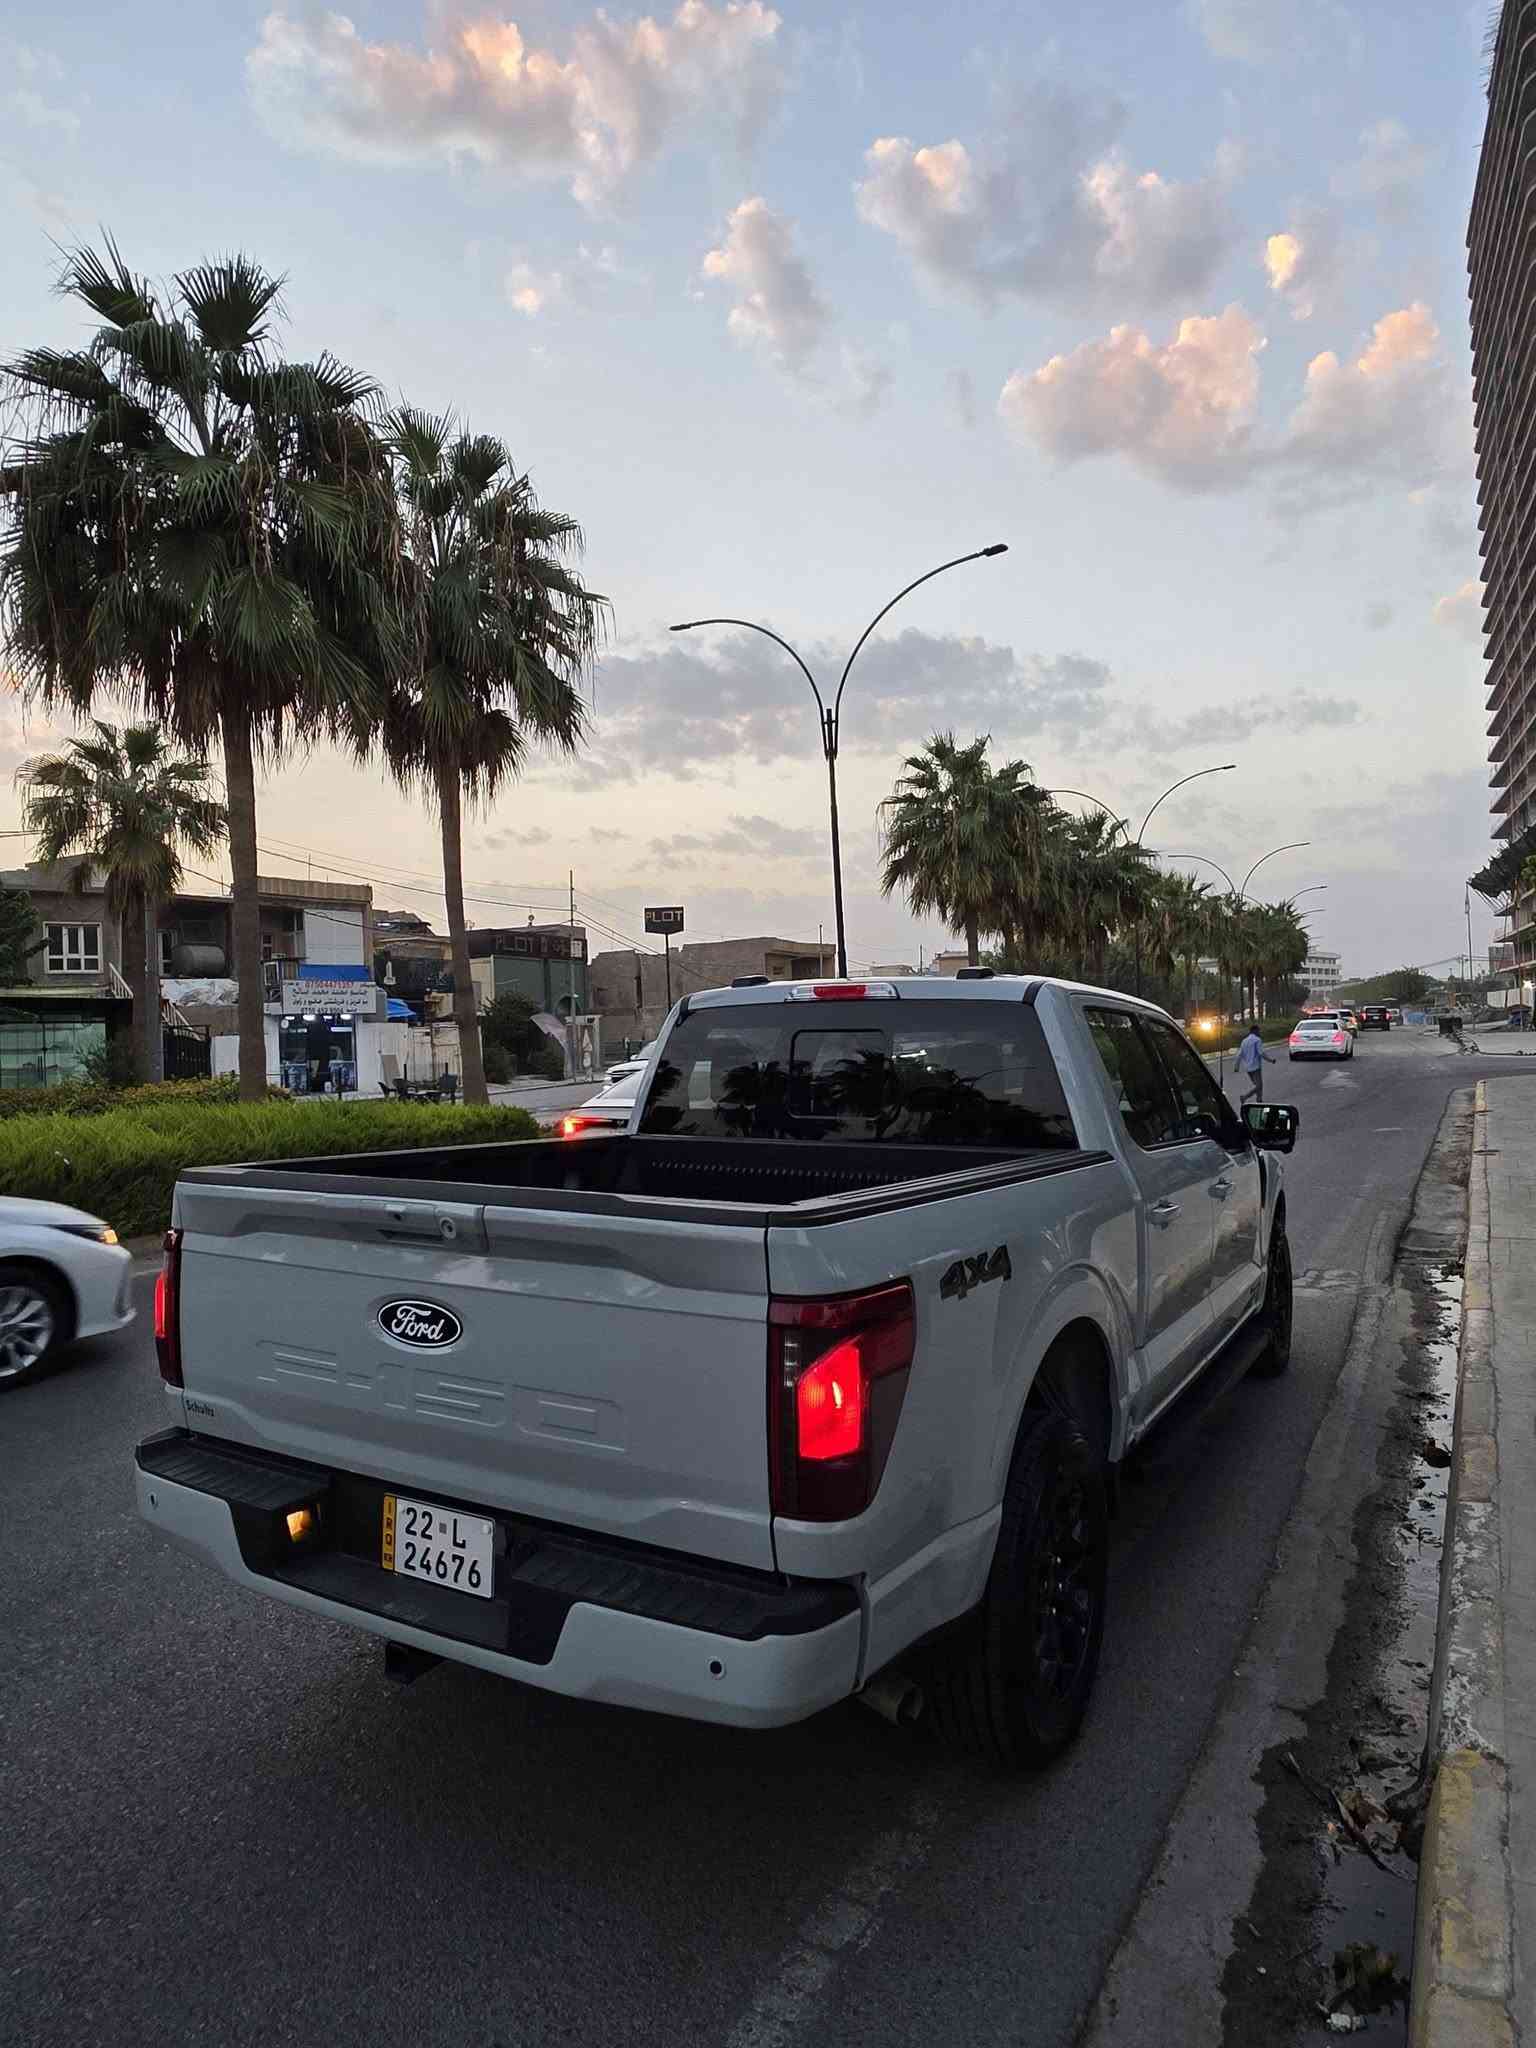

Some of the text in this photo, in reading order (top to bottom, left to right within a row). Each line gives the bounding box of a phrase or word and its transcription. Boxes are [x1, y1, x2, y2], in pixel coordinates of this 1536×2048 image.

[391, 1305, 445, 1340] Ford
[405, 1507, 466, 1549] 22 L
[404, 1541, 481, 1588] 24676
